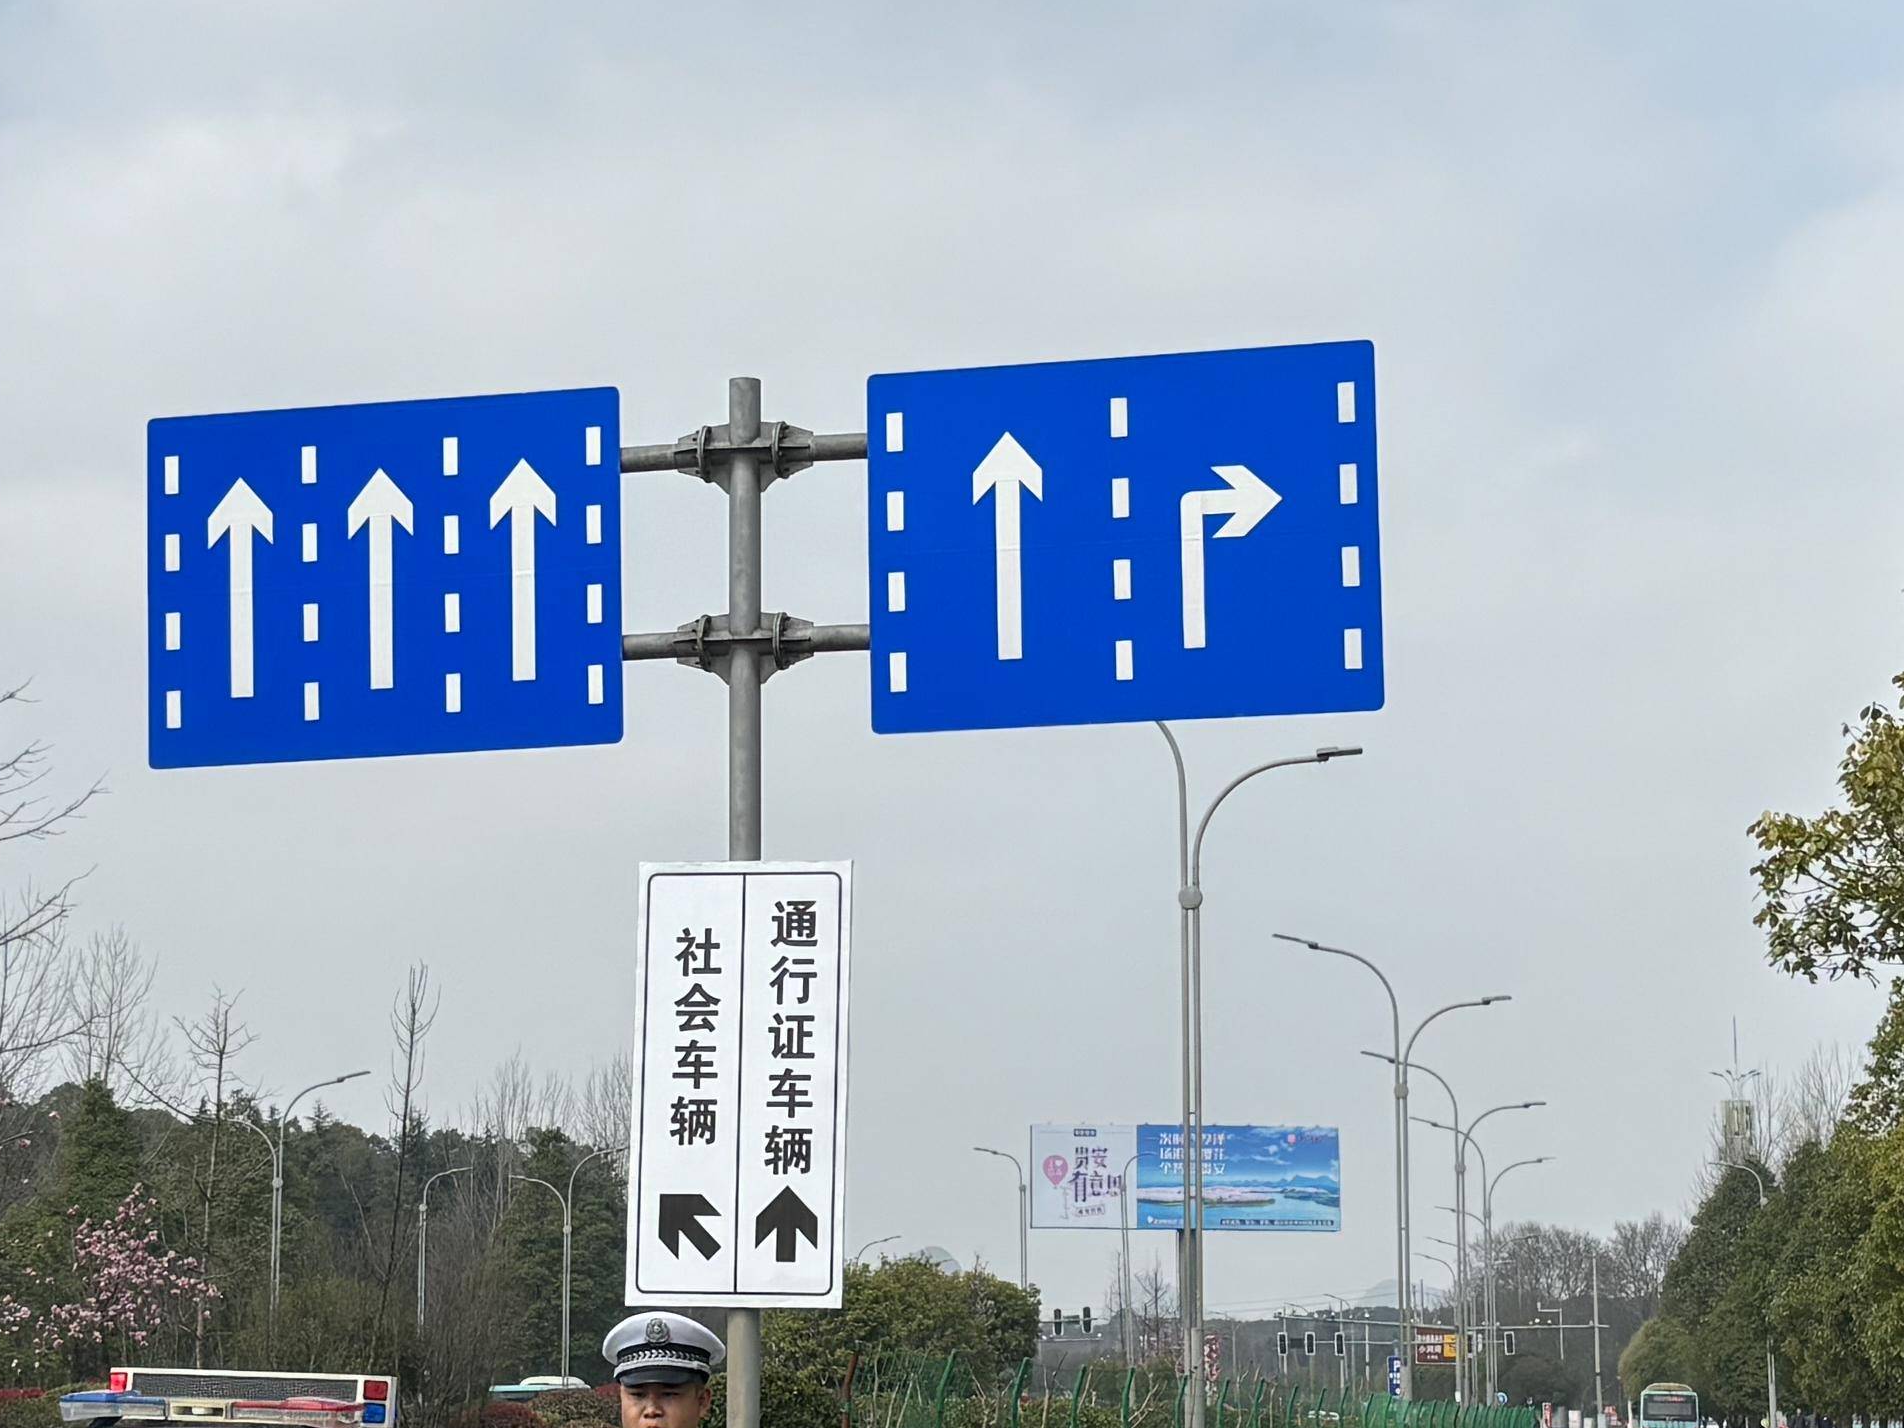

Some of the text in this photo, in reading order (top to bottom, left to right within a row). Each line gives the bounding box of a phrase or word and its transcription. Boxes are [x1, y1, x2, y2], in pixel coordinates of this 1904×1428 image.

[669, 927, 722, 1146] 社会车辆
[763, 900, 819, 1176] 通行证车辆
